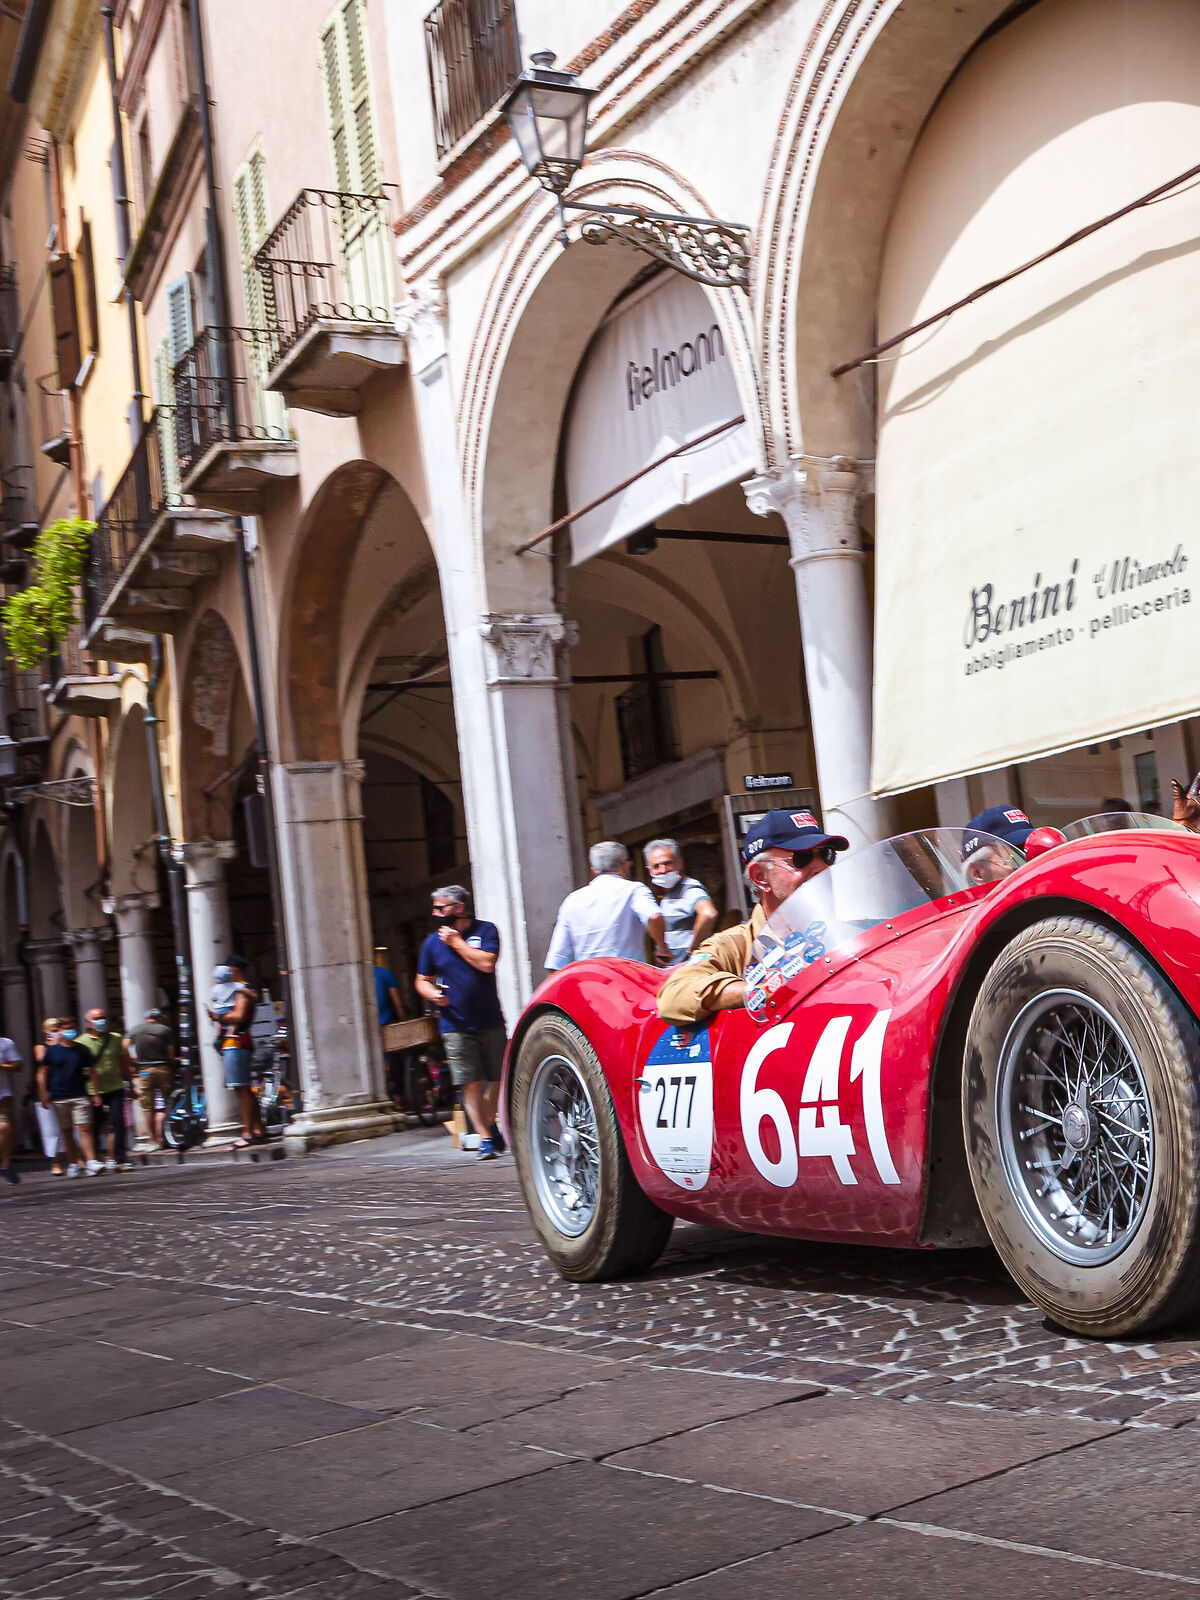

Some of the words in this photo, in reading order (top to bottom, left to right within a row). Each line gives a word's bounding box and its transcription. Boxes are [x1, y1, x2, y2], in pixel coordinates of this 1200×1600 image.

[626, 324, 725, 411] fielmann
[963, 558, 1080, 649] Benini
[1096, 543, 1190, 600] Miracolo
[965, 626, 1075, 676] abbigliamento
[1090, 587, 1192, 639] pellicceria
[747, 838, 764, 855] 277
[964, 836, 979, 853] 277
[655, 1075, 697, 1129] 277
[739, 1008, 902, 1188] 641
